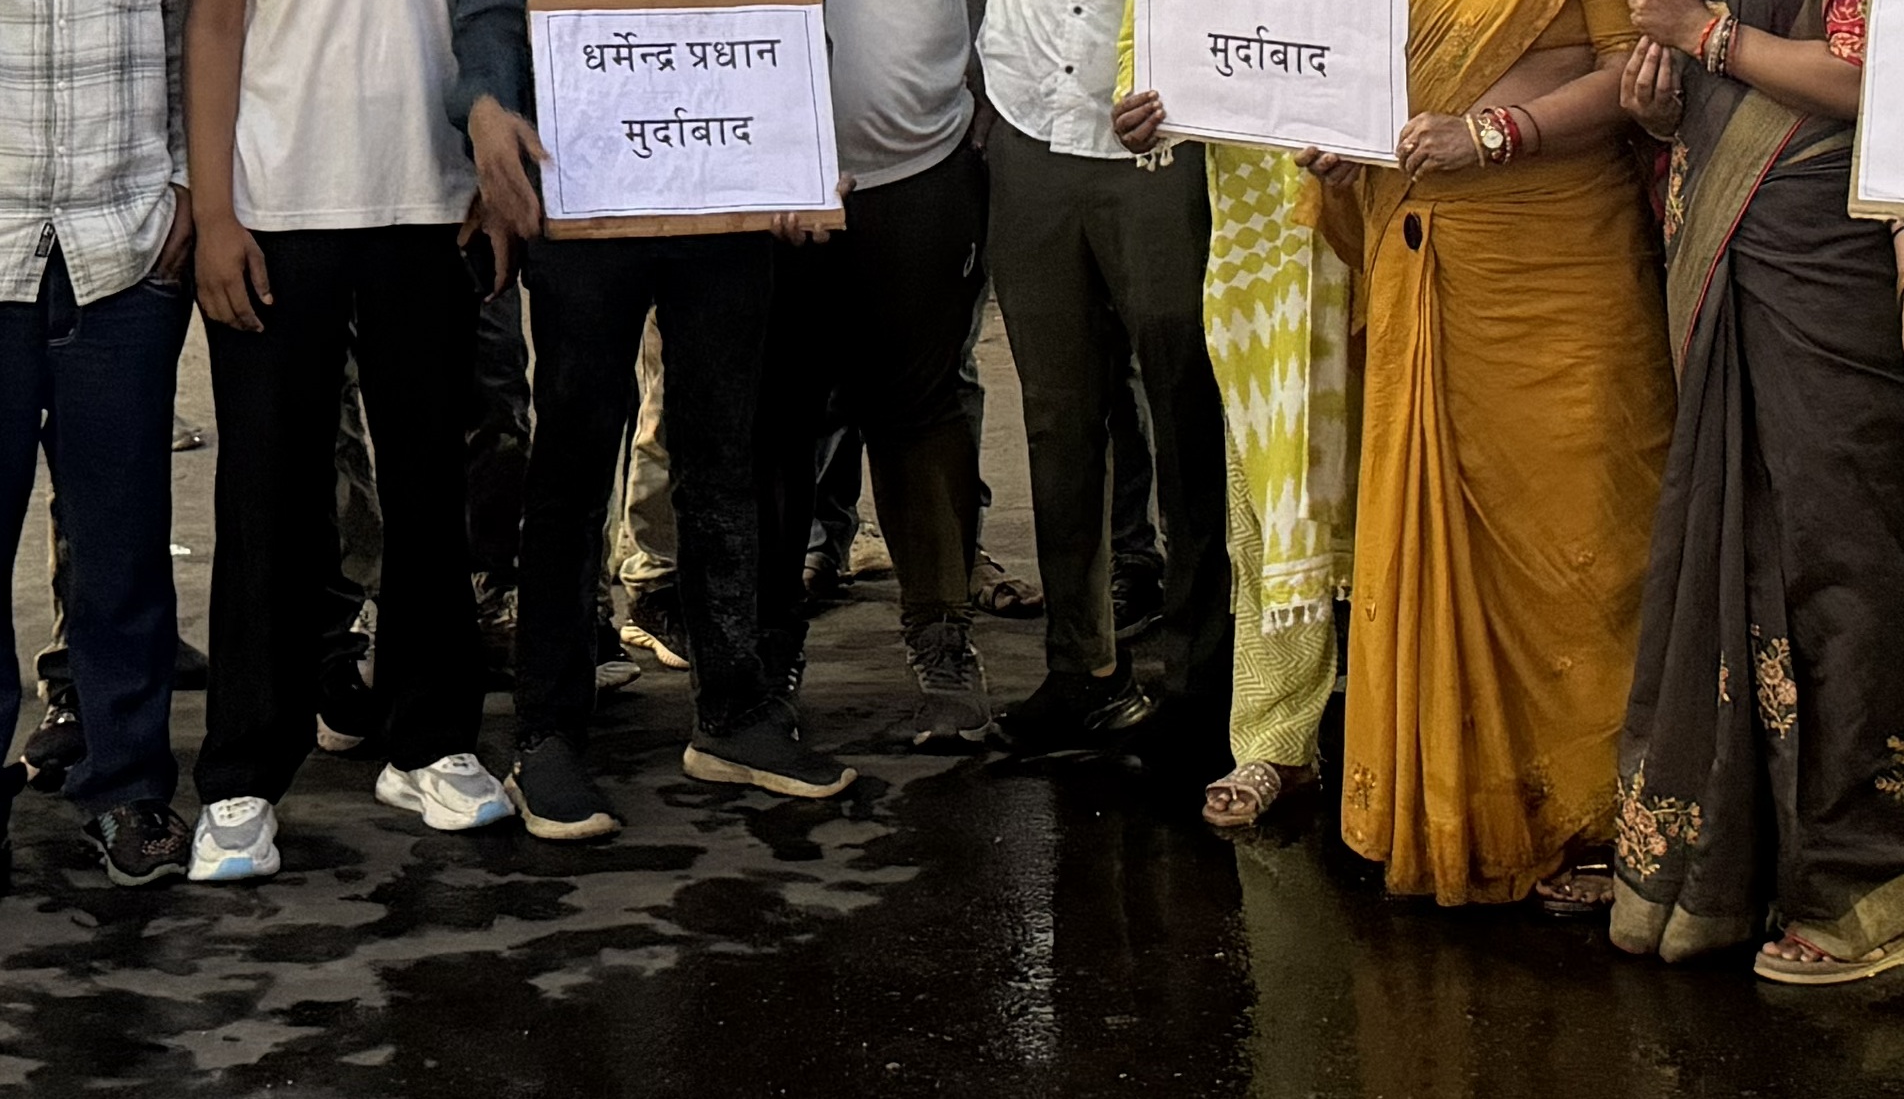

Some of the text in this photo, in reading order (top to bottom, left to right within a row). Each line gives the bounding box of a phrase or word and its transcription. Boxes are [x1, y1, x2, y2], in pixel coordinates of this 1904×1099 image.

[583, 31, 782, 73] धर्मेन्द्र प्रधान
[1207, 25, 1331, 78] मुर्दाबाद
[621, 106, 755, 160] मुर्दाबाद
